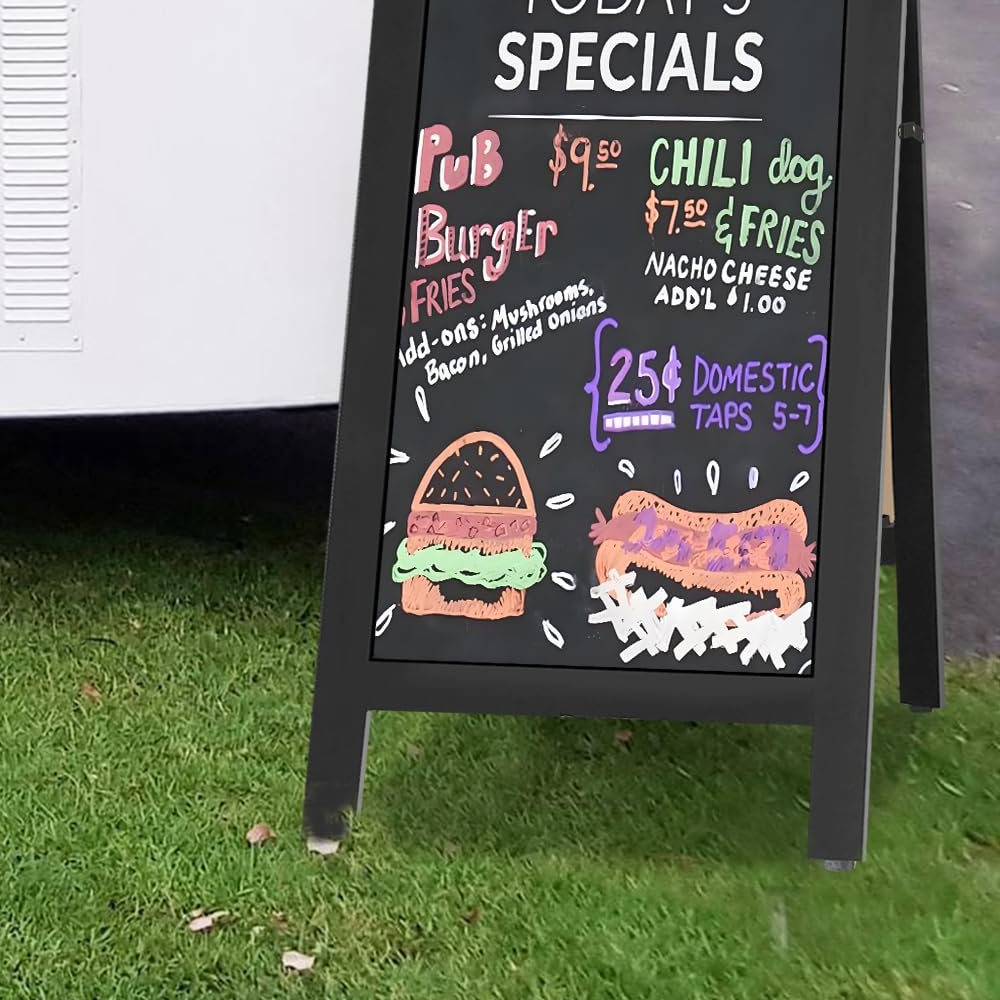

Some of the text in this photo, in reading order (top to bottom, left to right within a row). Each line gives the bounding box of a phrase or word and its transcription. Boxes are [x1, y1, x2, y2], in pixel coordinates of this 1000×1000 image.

[494, 30, 764, 92] SPECIALS
[650, 137, 752, 188] CHILI
[739, 204, 825, 265] FRIES
[410, 268, 477, 323] FRIES
[645, 251, 812, 291] NACHO CHEESE
[654, 284, 717, 311] ADD'L
[424, 349, 488, 386] Bacon,
[491, 318, 543, 357] Grilled
[607, 345, 682, 406] 25¢
[692, 355, 816, 396] DOMESTIC
[690, 402, 812, 431] TAPS 5-7
